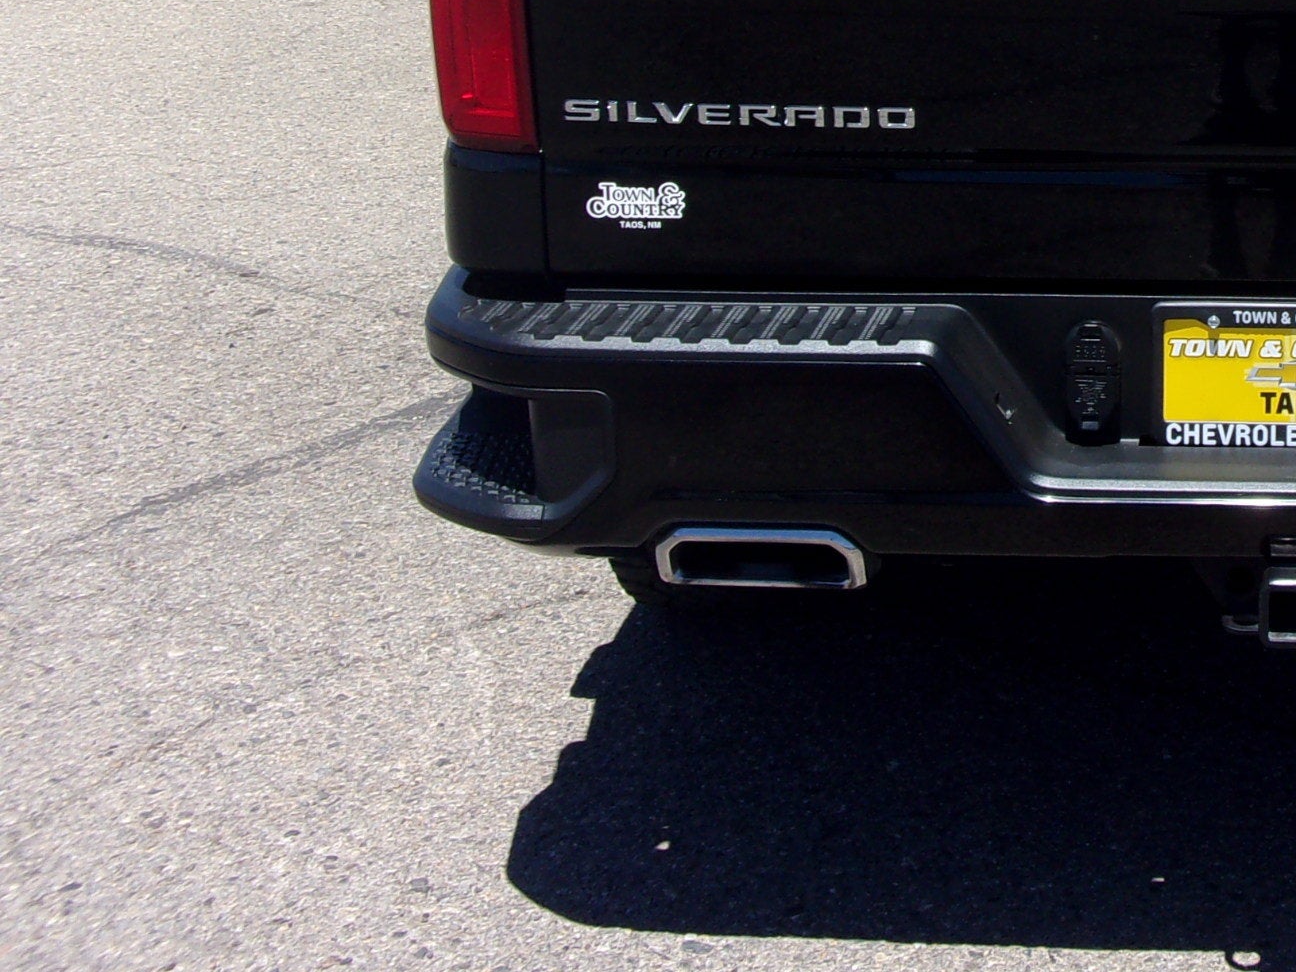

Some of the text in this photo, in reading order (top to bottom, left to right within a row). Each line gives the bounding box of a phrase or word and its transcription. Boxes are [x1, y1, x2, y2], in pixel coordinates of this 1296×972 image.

[564, 98, 917, 130] SILVERADO
[660, 183, 684, 207] &
[618, 220, 662, 230] TAOS, NM
[1233, 310, 1278, 325] TOWN
[1281, 311, 1291, 325] &
[1167, 338, 1252, 359] TOWN
[1259, 339, 1283, 359] &
